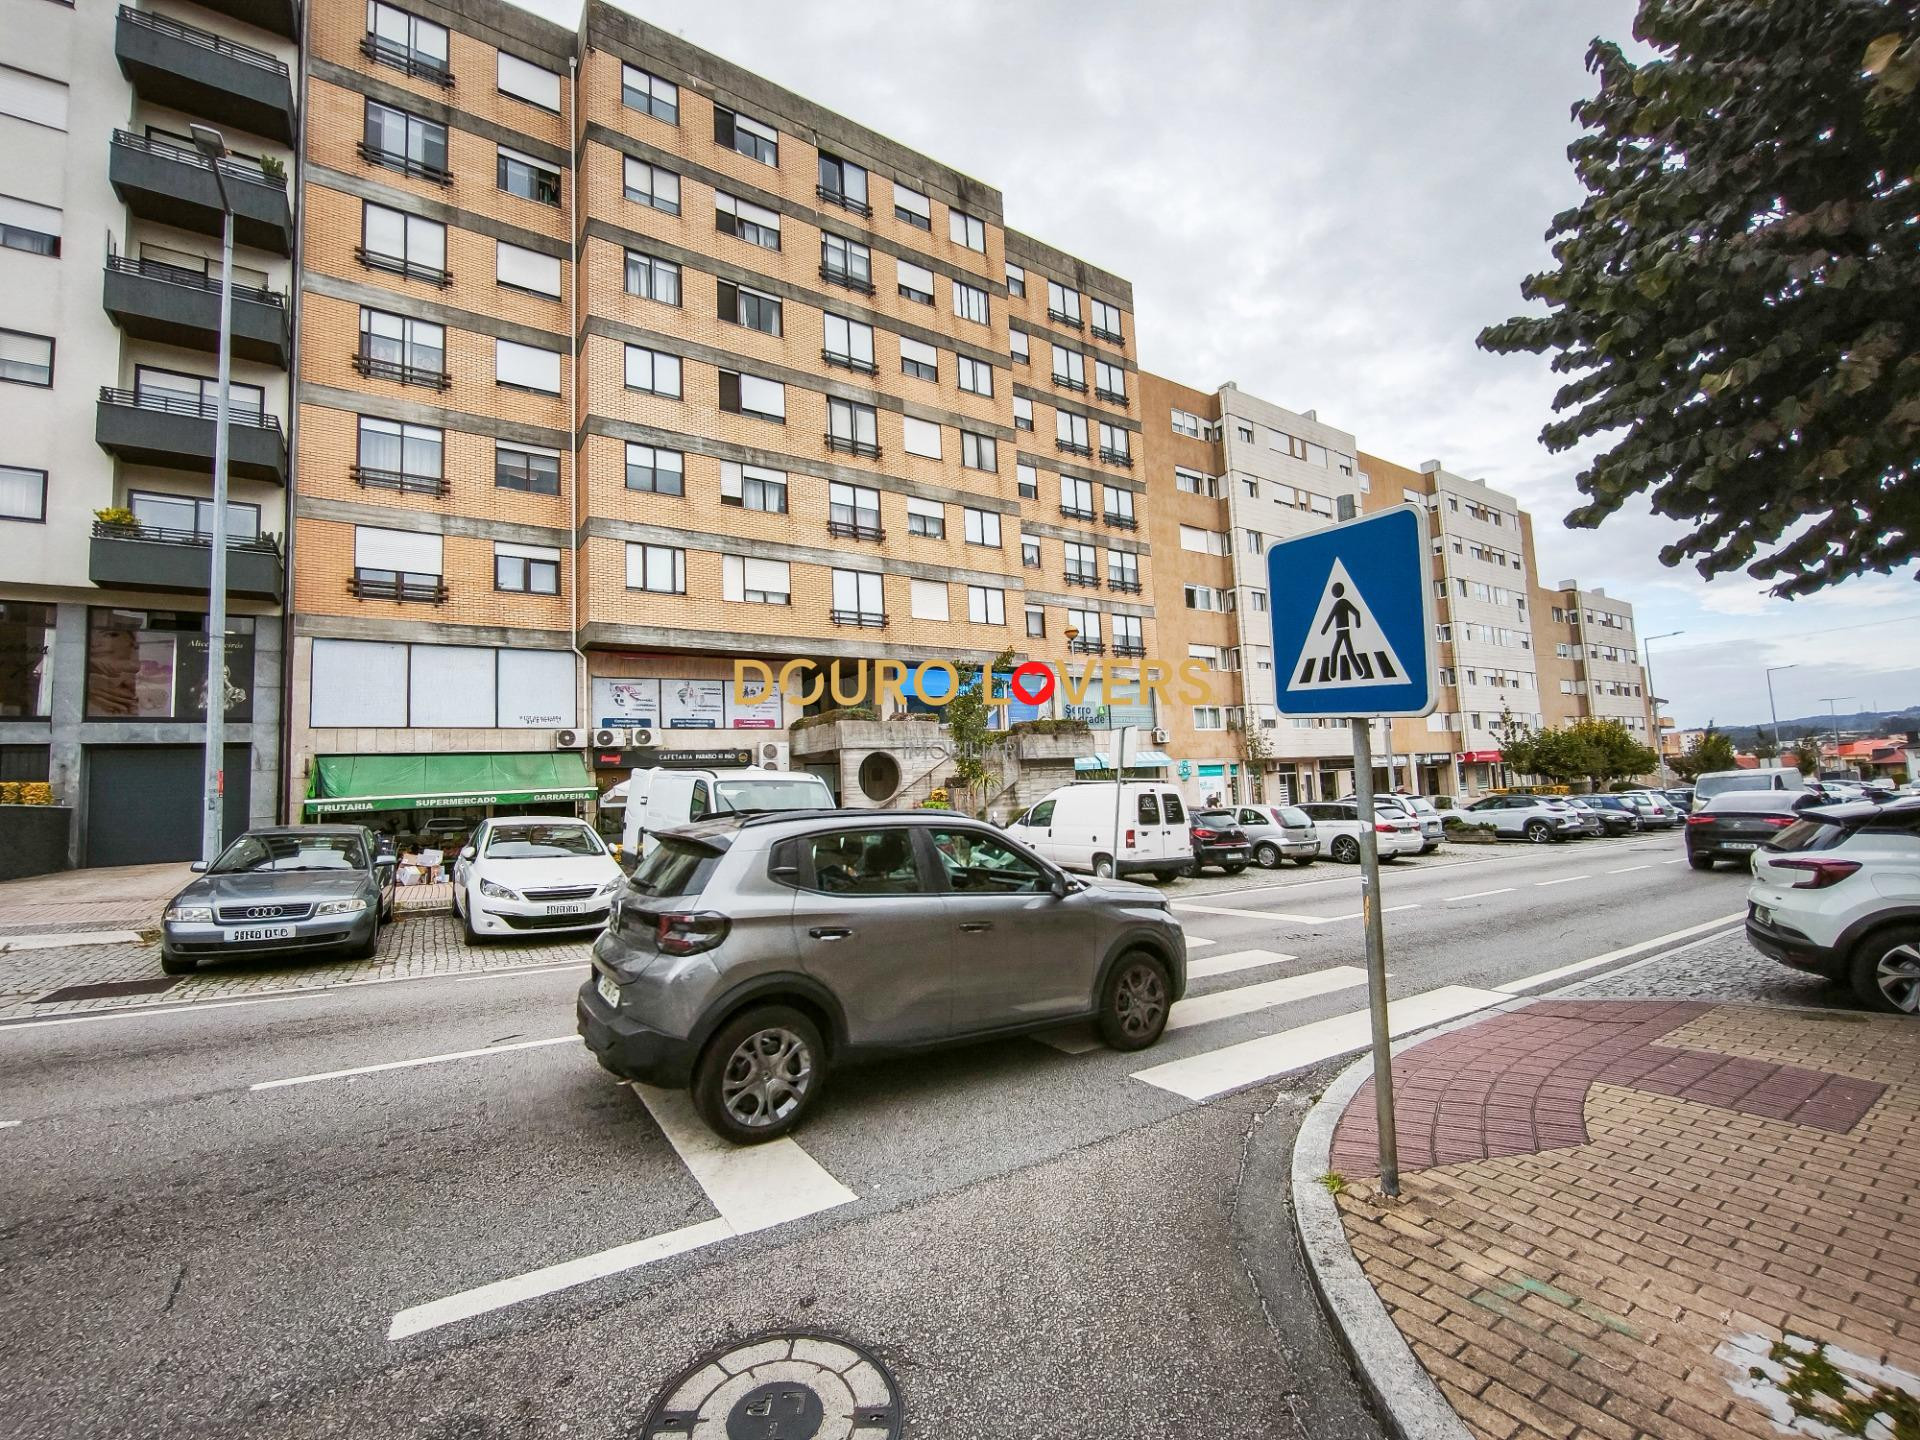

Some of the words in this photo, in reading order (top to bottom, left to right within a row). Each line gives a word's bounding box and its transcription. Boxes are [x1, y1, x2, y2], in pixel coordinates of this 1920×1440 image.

[1065, 704, 1091, 715] Serro
[659, 753, 693, 761] CAFETARIA
[317, 802, 374, 812] FRUTARIA
[415, 796, 497, 807] SUPERMERCADO
[533, 792, 590, 802] GARRAFEIRA
